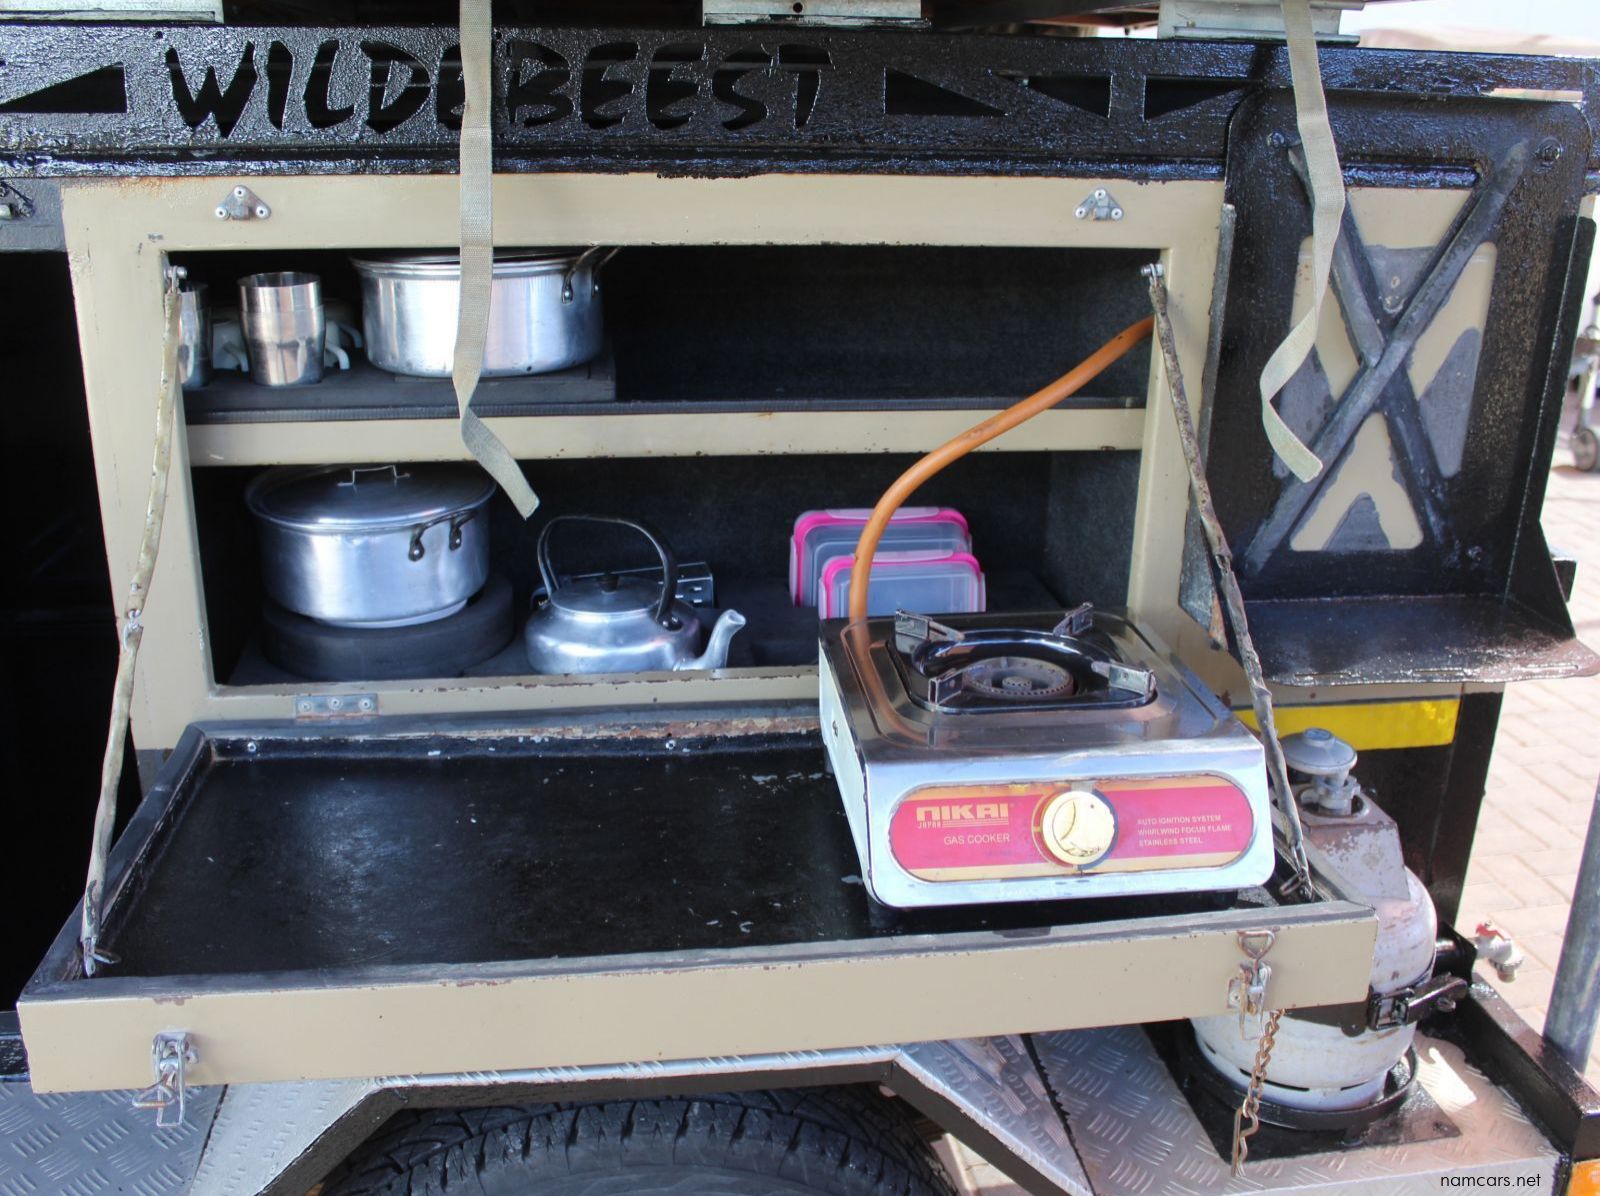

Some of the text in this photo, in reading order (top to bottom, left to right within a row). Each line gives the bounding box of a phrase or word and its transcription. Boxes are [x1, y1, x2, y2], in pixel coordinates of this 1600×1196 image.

[163, 40, 833, 138] WILDEBEEST
[1159, 816, 1190, 824] IGNITION
[1192, 814, 1221, 823] SYSTEM
[1138, 824, 1232, 835] WHIRLWIND FOCUS FLAME
[943, 832, 1010, 845] GAS COOKER
[1139, 837, 1202, 847] STAINLESS STEEL
